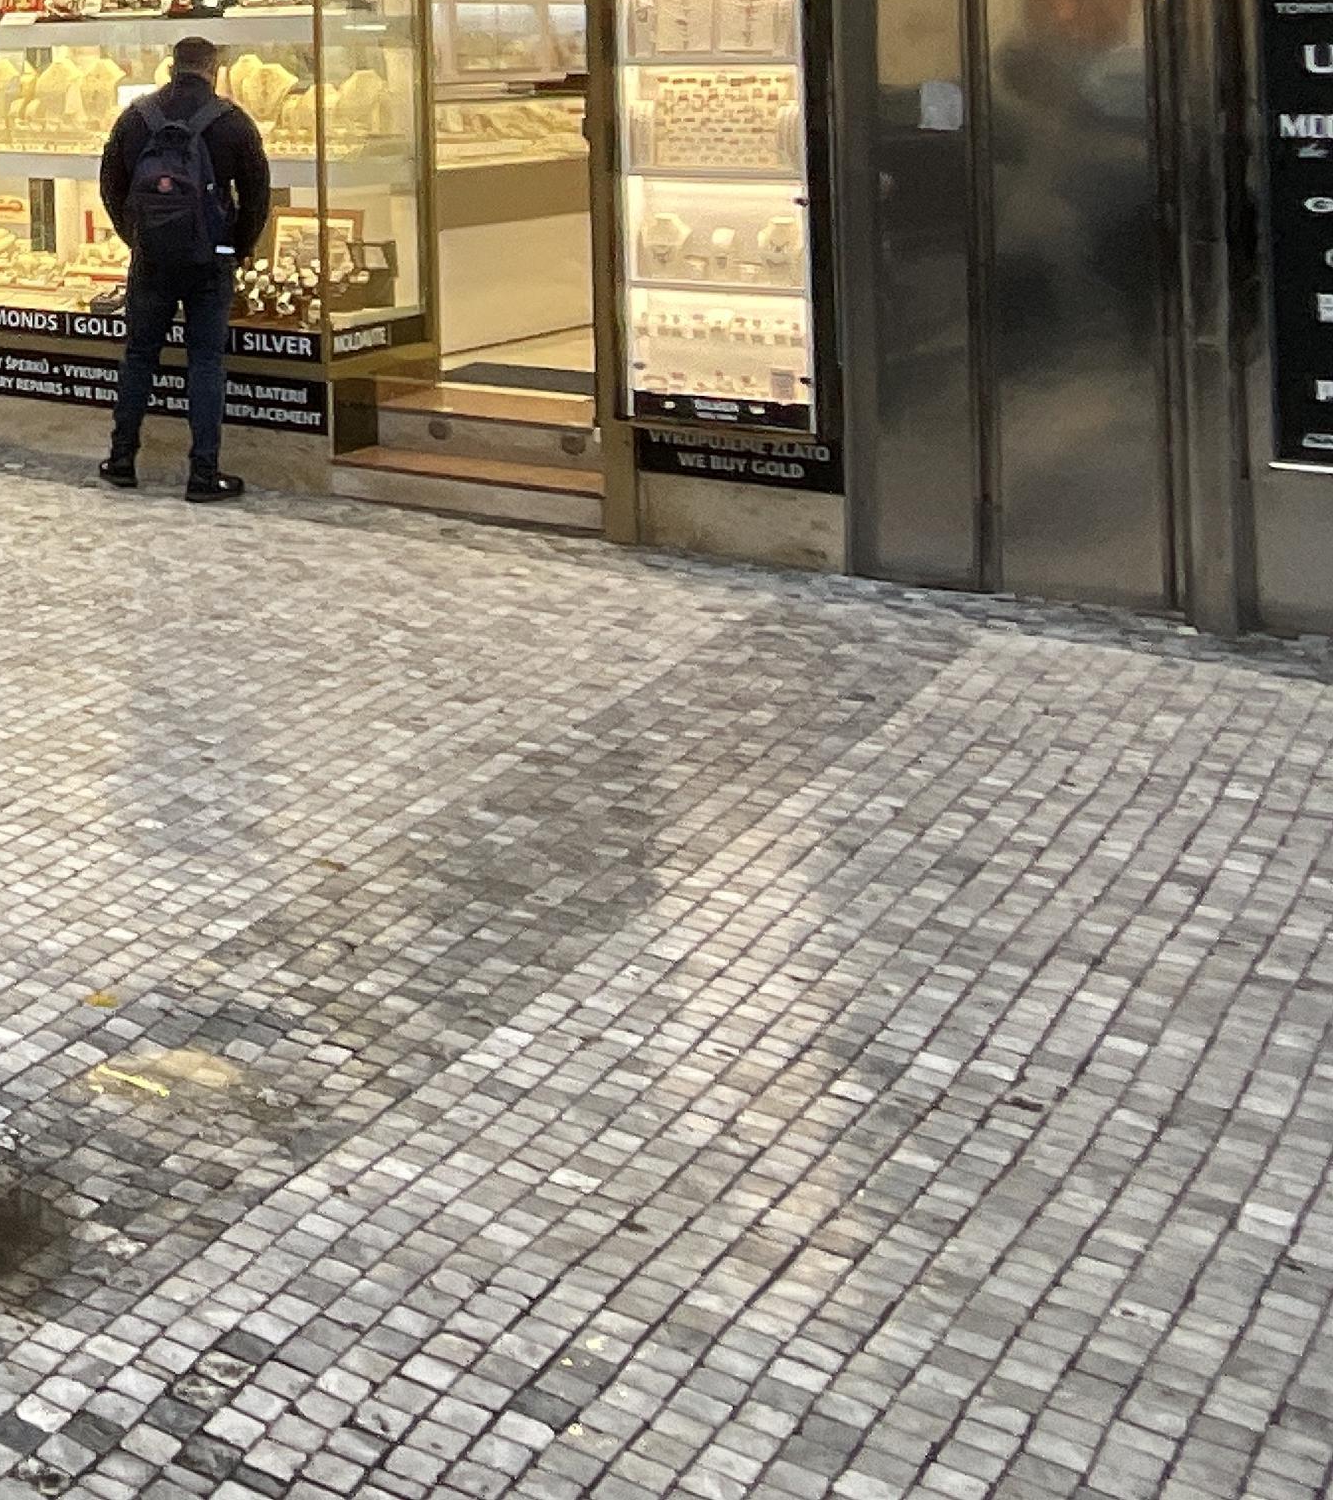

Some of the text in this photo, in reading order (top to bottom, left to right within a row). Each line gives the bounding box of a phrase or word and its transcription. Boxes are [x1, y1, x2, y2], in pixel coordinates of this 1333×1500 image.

[73, 318, 126, 337] GOLD
[242, 332, 312, 357] SILVER
[16, 378, 63, 396] REPAIRS
[225, 403, 322, 426] REPLACEMENT
[676, 451, 805, 479] WE BUY GOLD
